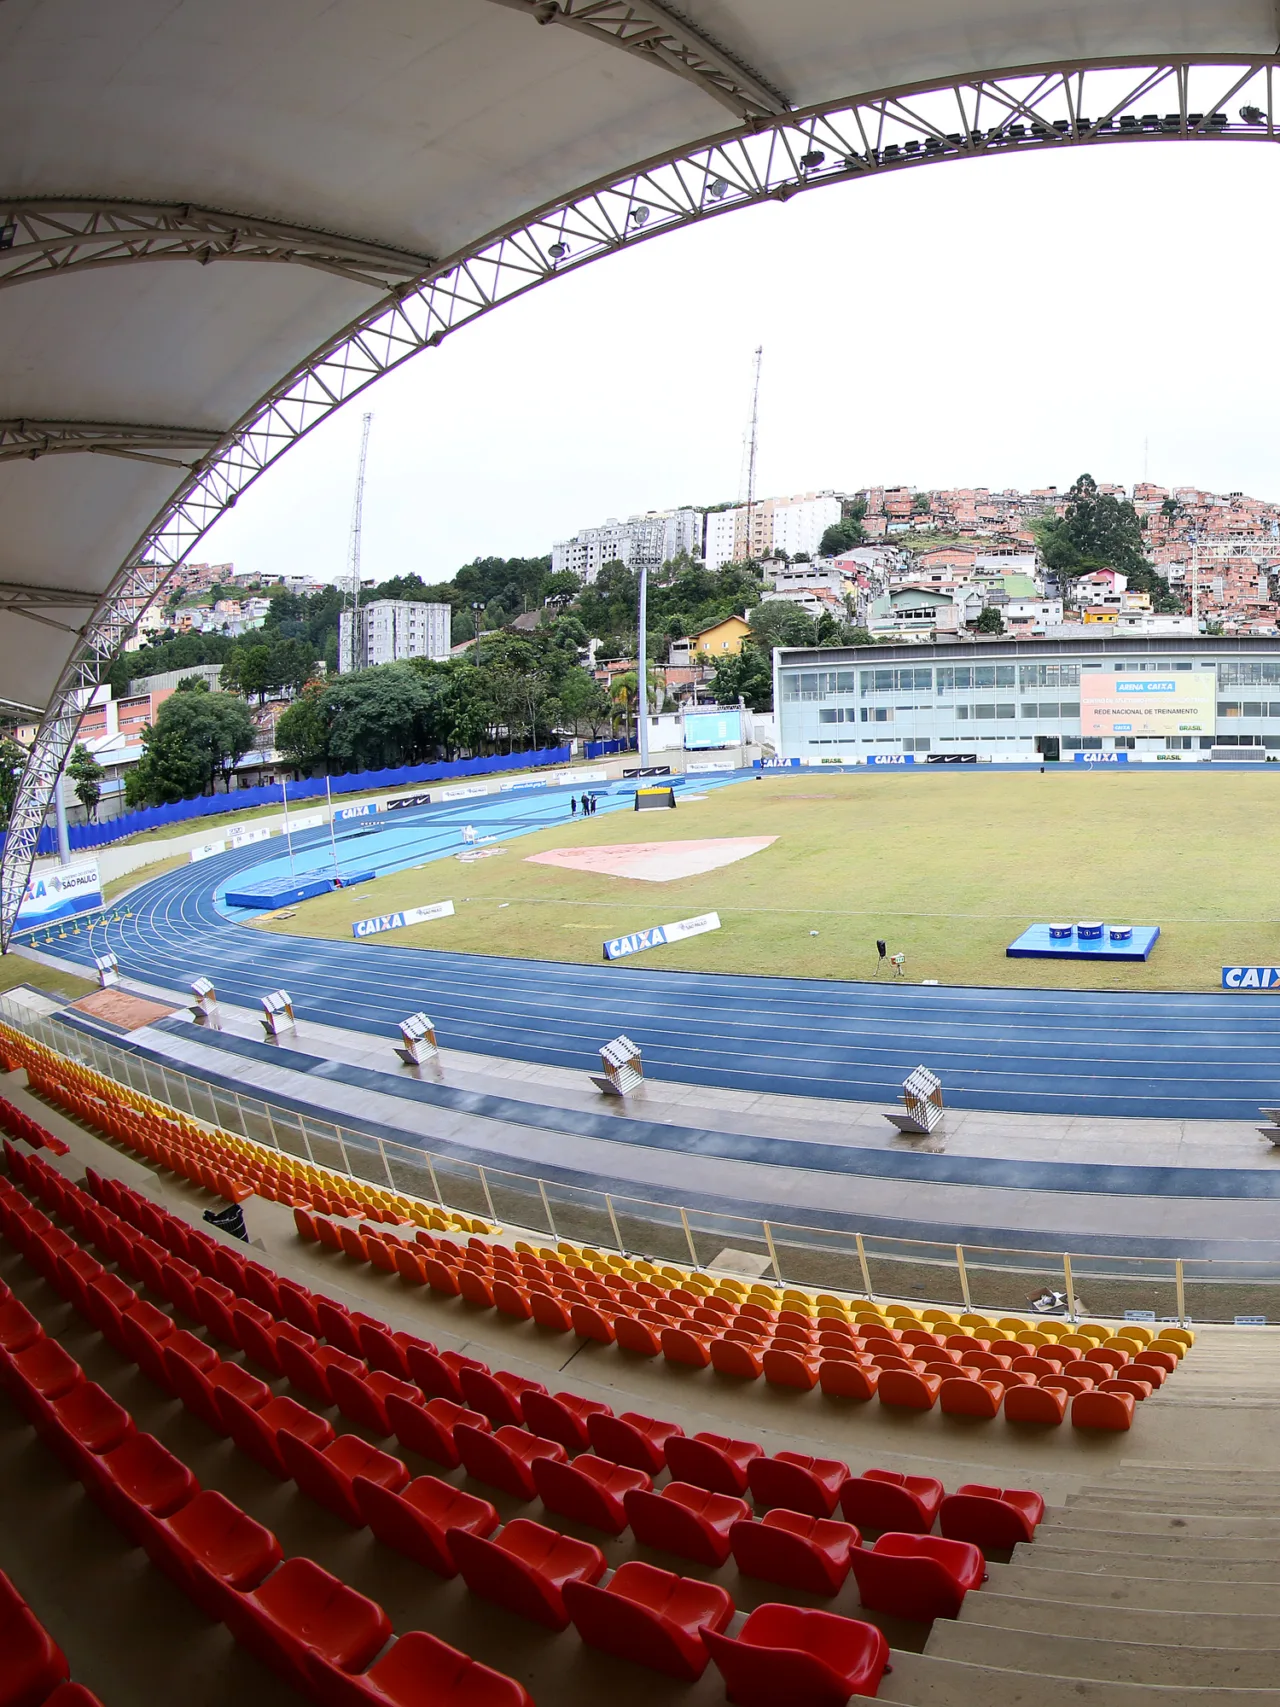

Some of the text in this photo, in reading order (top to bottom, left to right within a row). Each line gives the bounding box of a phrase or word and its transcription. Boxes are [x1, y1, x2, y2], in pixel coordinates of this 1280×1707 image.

[1118, 683, 1144, 691] ARENA
[874, 755, 905, 764] CAIXA
[1083, 753, 1118, 762] CAIXA
[342, 805, 370, 819] CAIXA
[77, 873, 97, 886] PAULO
[357, 914, 403, 936] CAIXA
[609, 928, 664, 957] CAIXA
